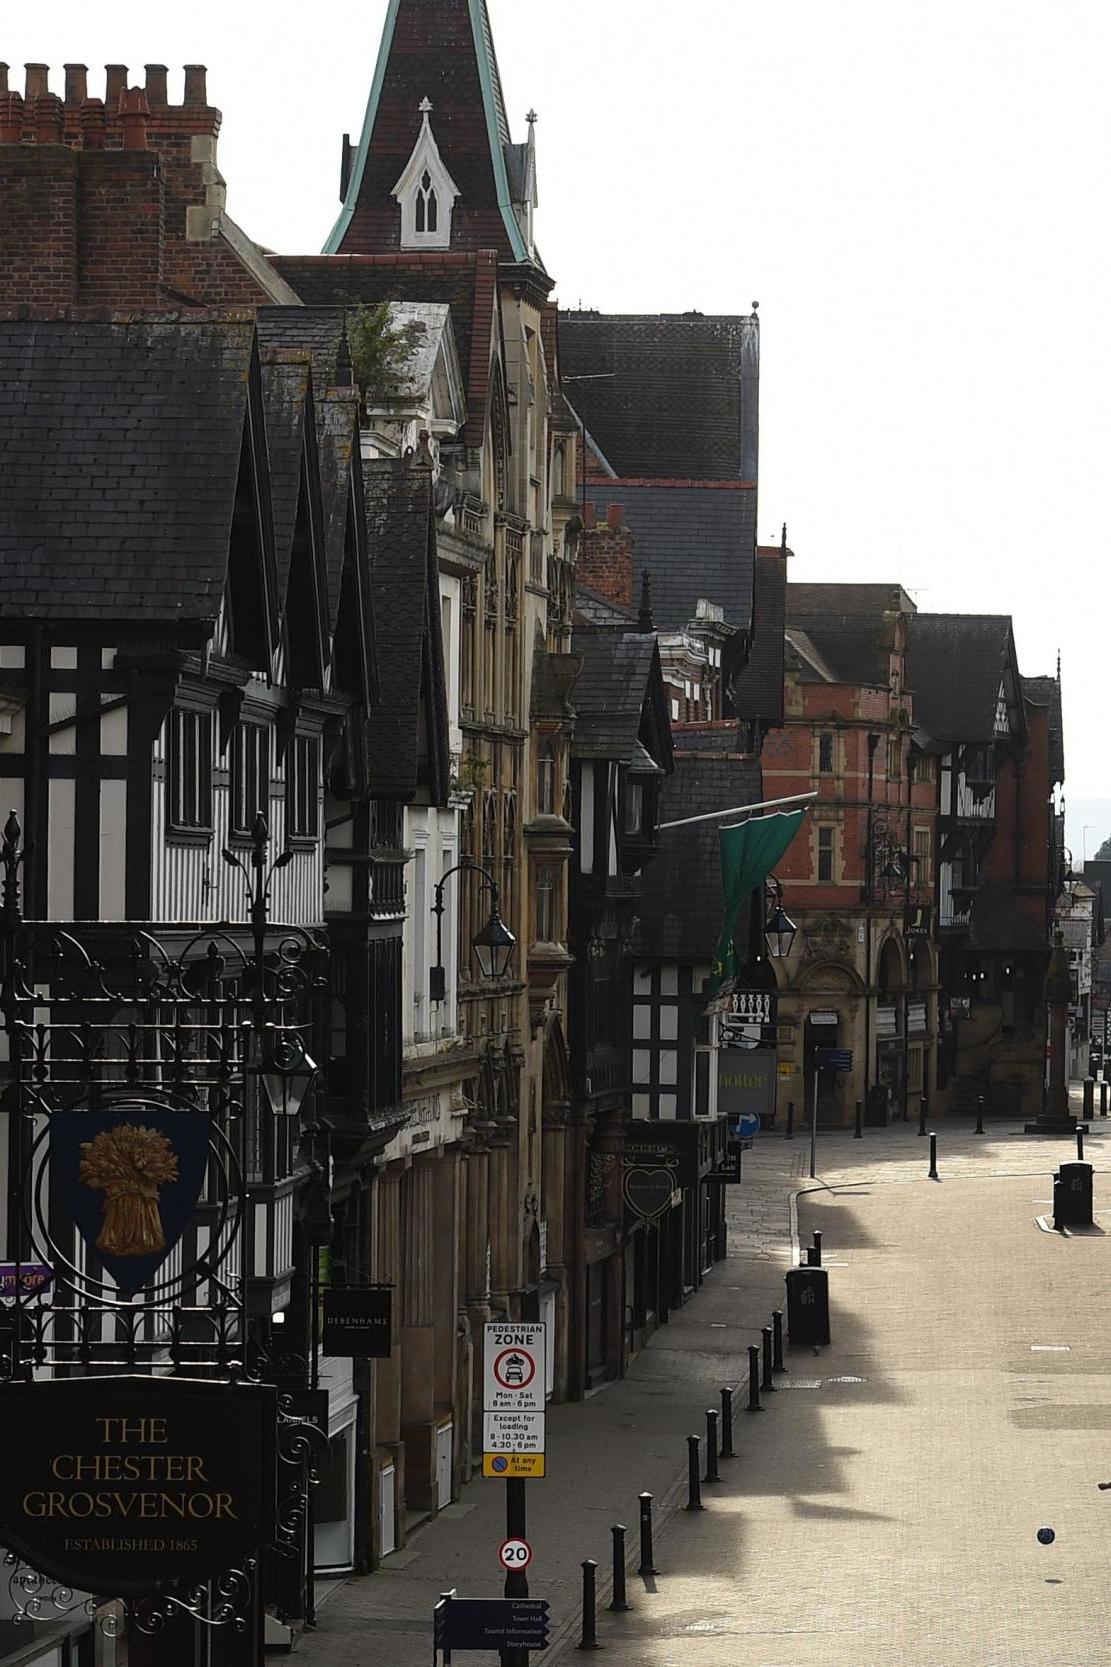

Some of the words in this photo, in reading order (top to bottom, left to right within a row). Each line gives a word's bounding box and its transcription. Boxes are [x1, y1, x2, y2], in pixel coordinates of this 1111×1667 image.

[328, 1317, 387, 1325] DEBENHAMS
[494, 1334, 534, 1345] ZONE
[517, 1400, 522, 1408] 6
[494, 1414, 521, 1423] Except
[524, 1414, 535, 1422] for
[94, 1417, 168, 1444] THE
[500, 1422, 529, 1431] loading
[522, 1458, 536, 1466] any
[52, 1455, 209, 1482] CHESTER
[515, 1464, 532, 1472] time
[22, 1492, 239, 1520] GROSVENOR
[64, 1538, 166, 1552] ESTABLISHED
[168, 1538, 198, 1552] 1865
[504, 1546, 528, 1562] 20
[506, 1640, 541, 1648] Storyhouse
